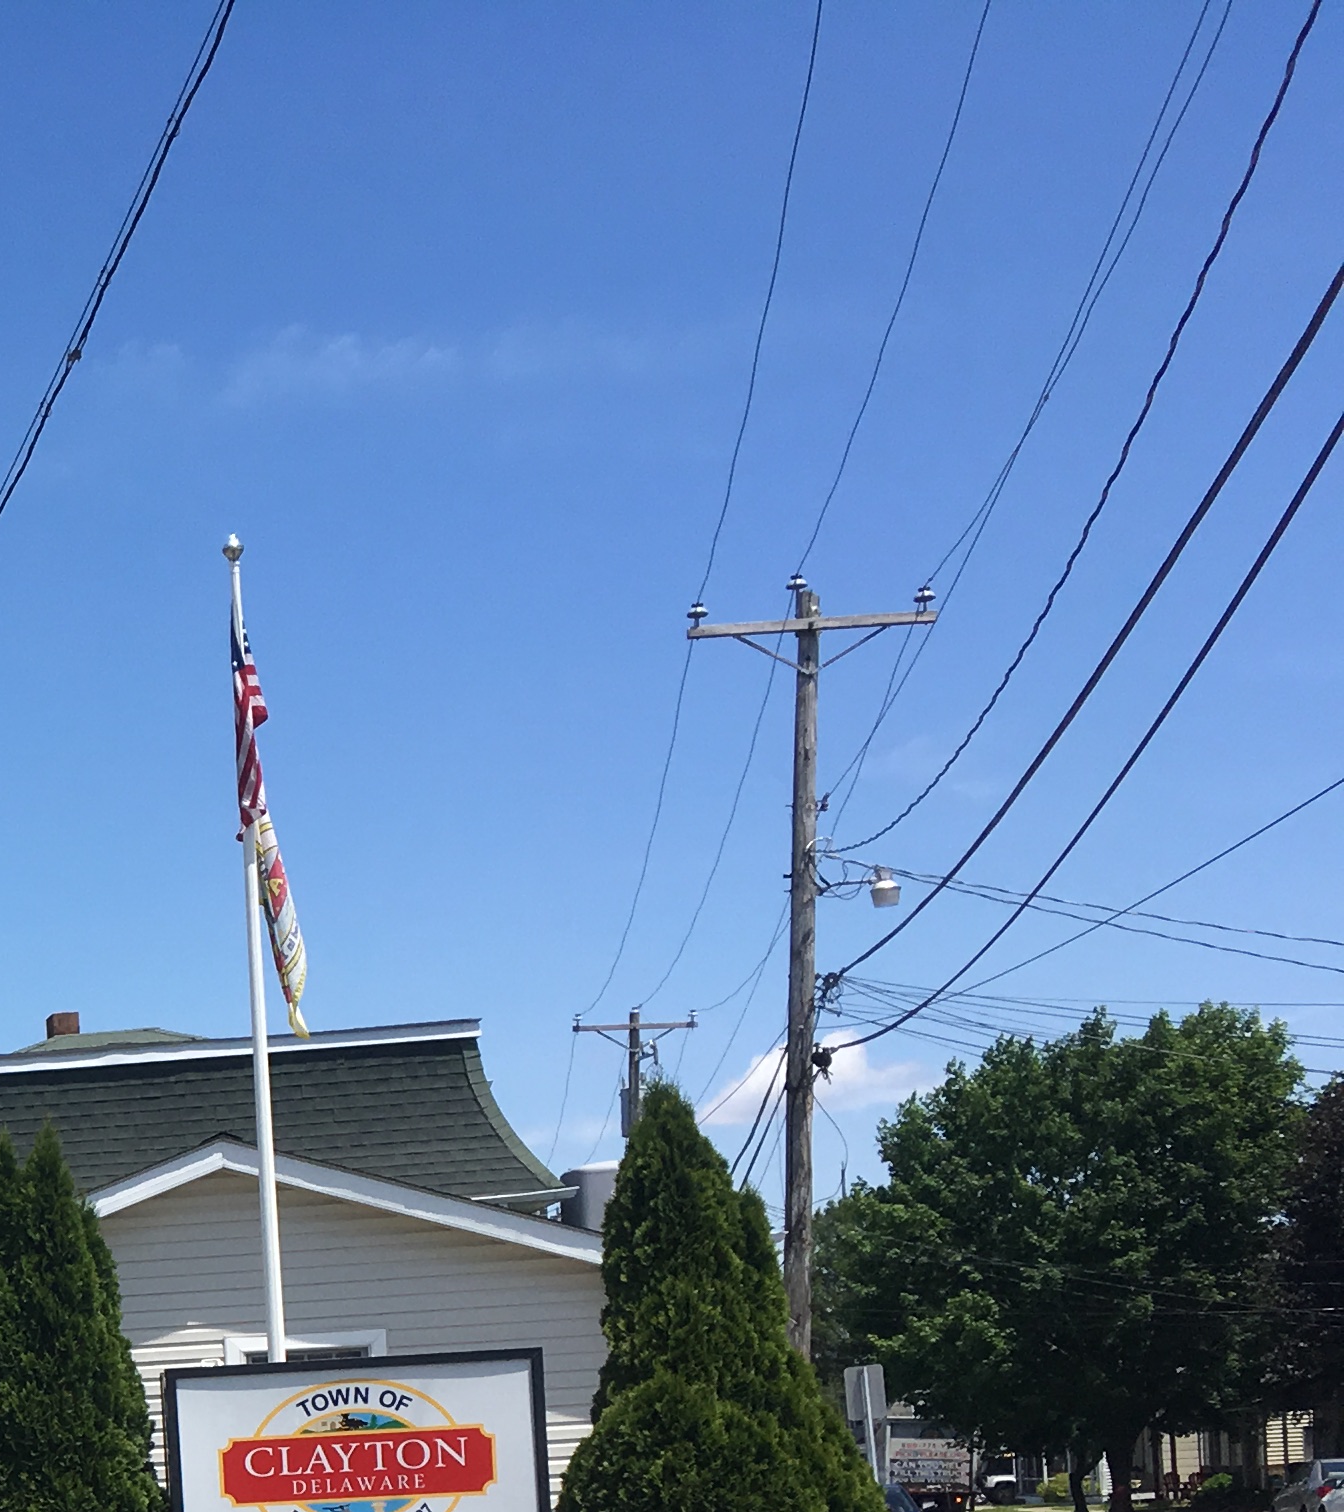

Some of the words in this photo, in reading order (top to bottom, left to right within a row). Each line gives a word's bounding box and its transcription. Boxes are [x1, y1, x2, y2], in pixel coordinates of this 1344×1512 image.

[296, 1386, 369, 1417] TOWN
[379, 1389, 413, 1412] OF
[244, 1436, 468, 1478] CLAYTON
[292, 1473, 426, 1495] DELAWARE
